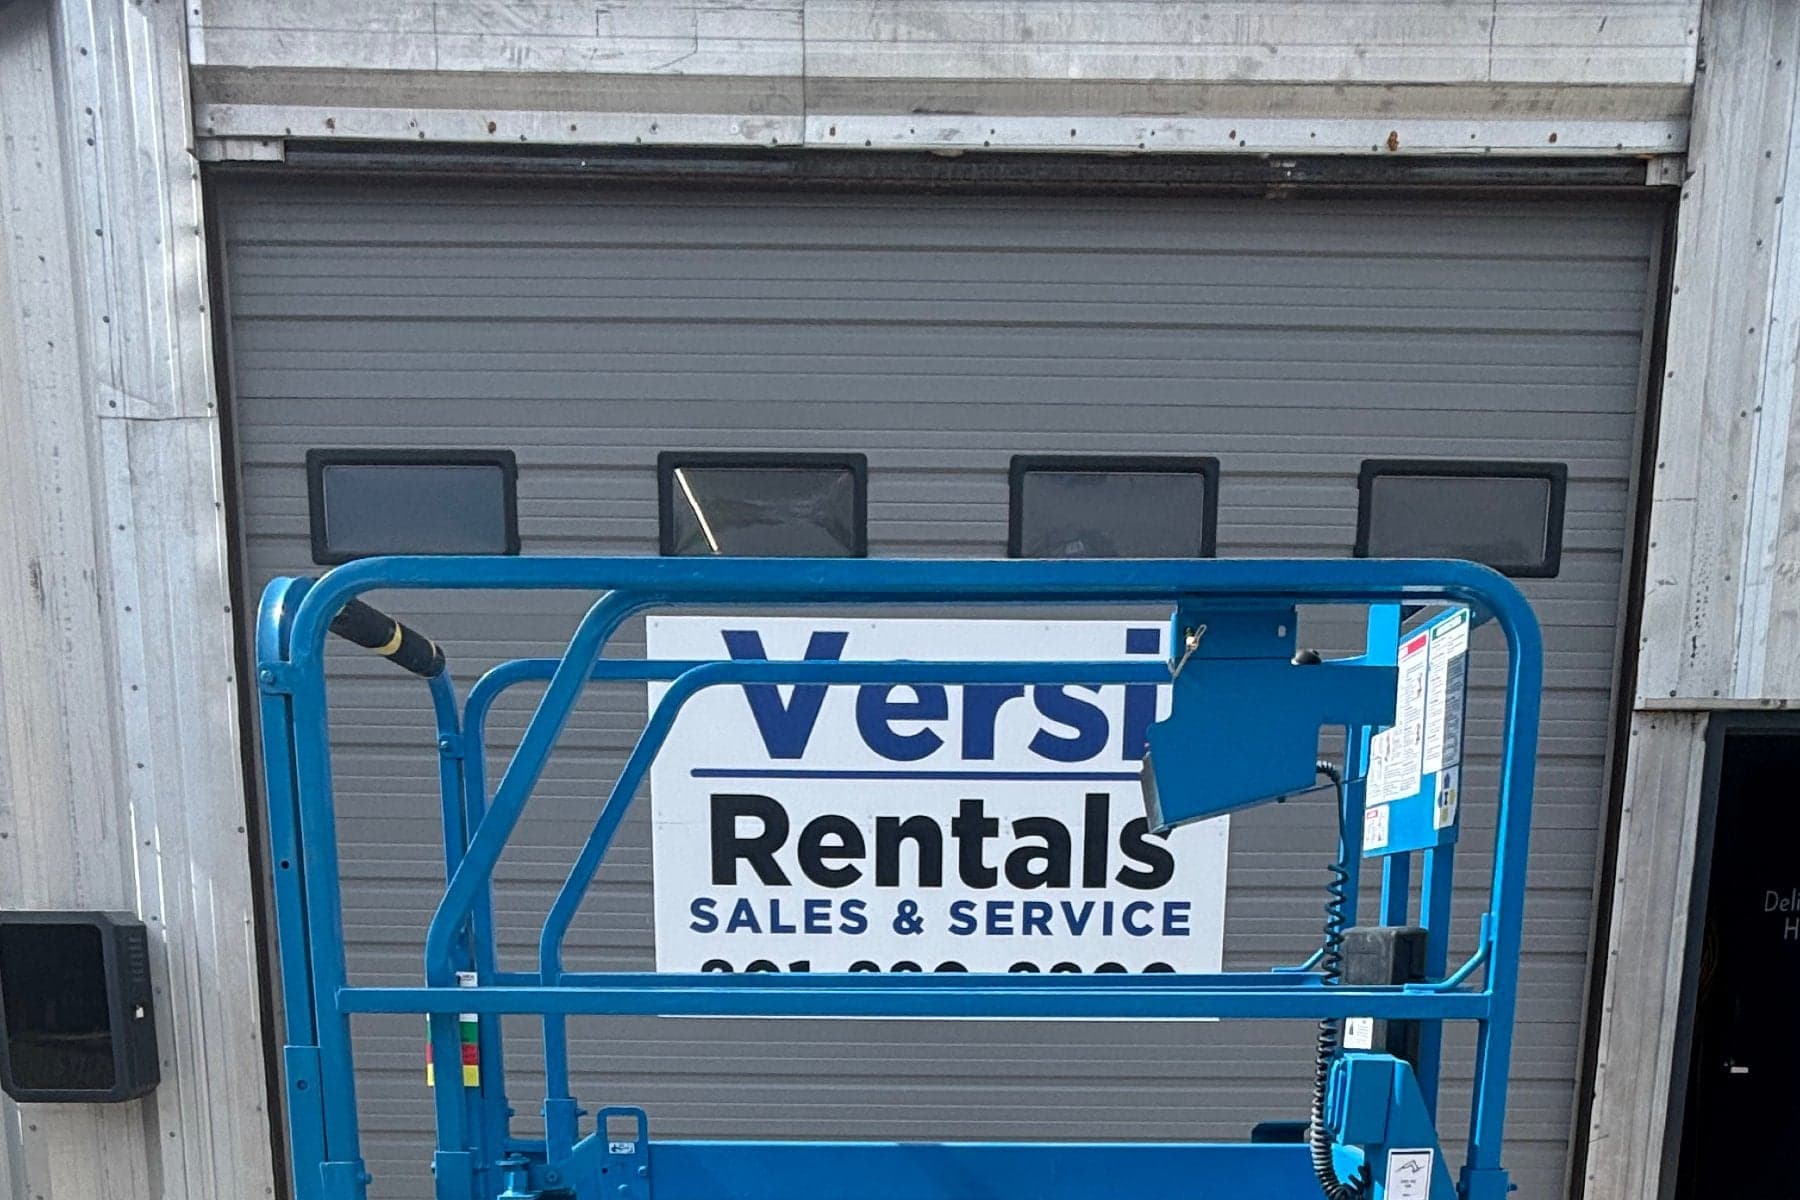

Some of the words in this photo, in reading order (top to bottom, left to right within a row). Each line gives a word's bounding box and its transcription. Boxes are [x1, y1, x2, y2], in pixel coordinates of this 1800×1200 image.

[722, 629, 1160, 762] Versi
[710, 792, 1176, 889] Rentals
[690, 897, 867, 934] SALES
[894, 900, 925, 935] &
[948, 900, 1191, 937] SERVICE
